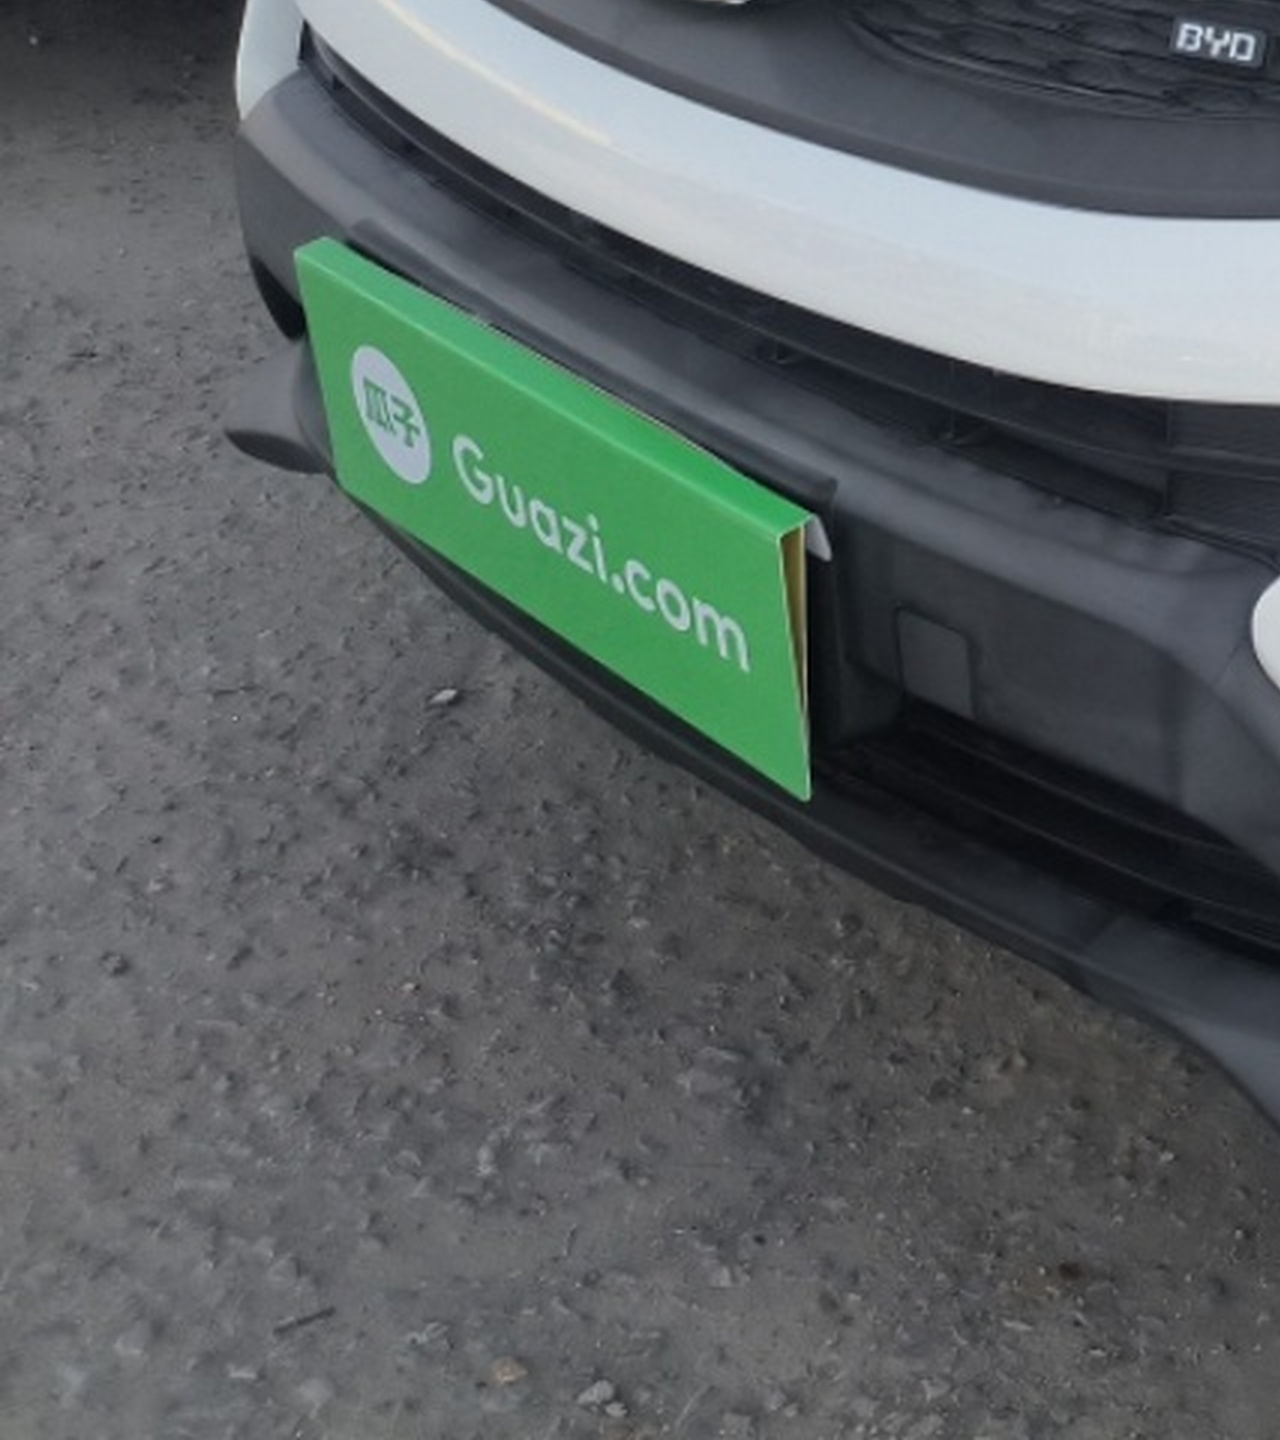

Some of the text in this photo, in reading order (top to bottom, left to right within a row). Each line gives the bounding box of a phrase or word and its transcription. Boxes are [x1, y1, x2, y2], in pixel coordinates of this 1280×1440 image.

[1176, 22, 1257, 61] BYD
[362, 376, 421, 450] 瓜子
[452, 433, 750, 674] Guazi.com
